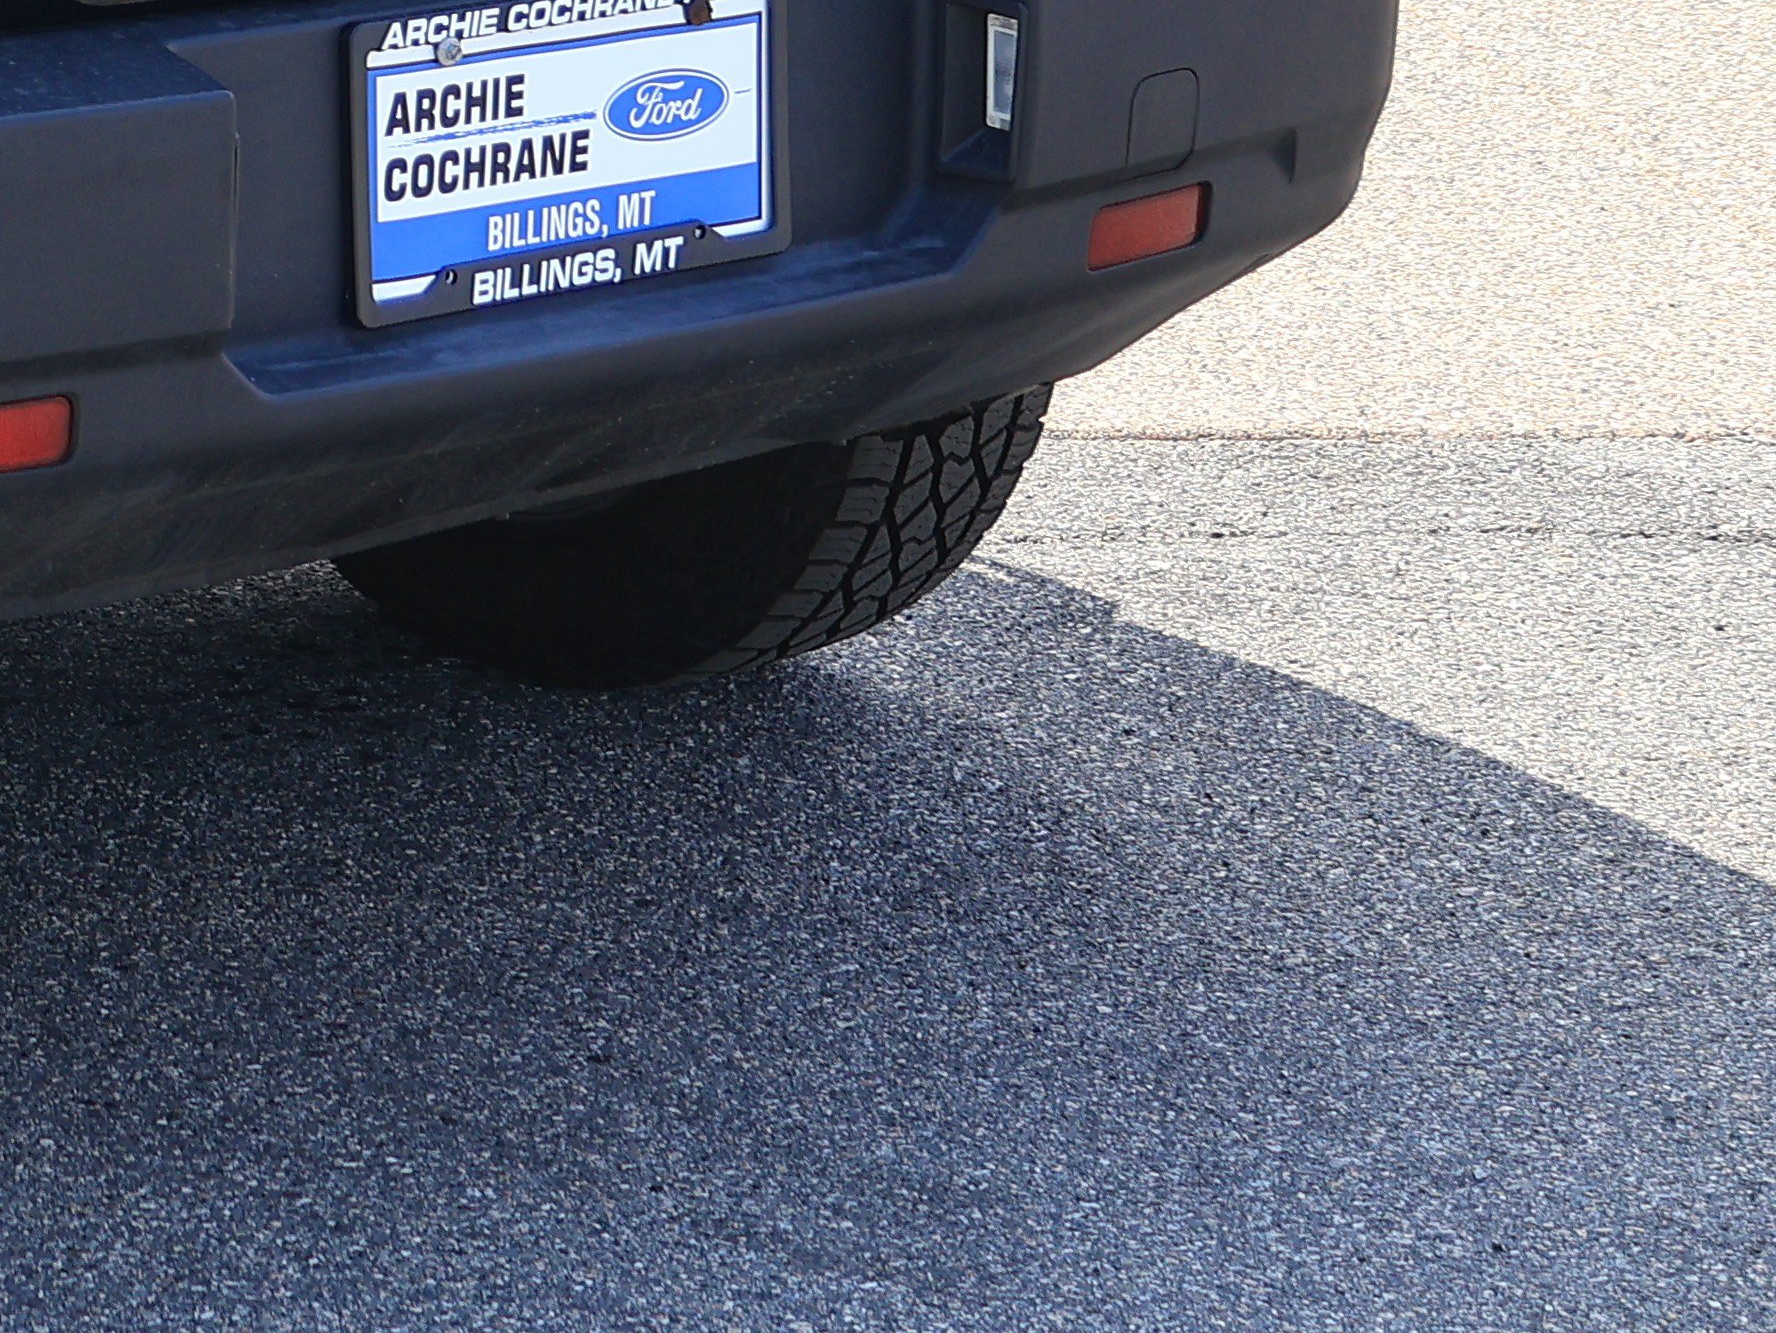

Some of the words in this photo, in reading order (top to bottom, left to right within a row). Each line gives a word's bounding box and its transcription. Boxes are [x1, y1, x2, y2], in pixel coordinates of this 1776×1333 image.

[381, 7, 500, 50] ARCHIE
[384, 73, 526, 137] ARCHIE
[629, 80, 704, 129] Ford
[384, 129, 591, 202] COCHRANE
[487, 198, 609, 252] BILLINGS,
[617, 190, 656, 230] MT
[472, 248, 622, 306] BILLINGS,
[634, 236, 684, 275] MT
